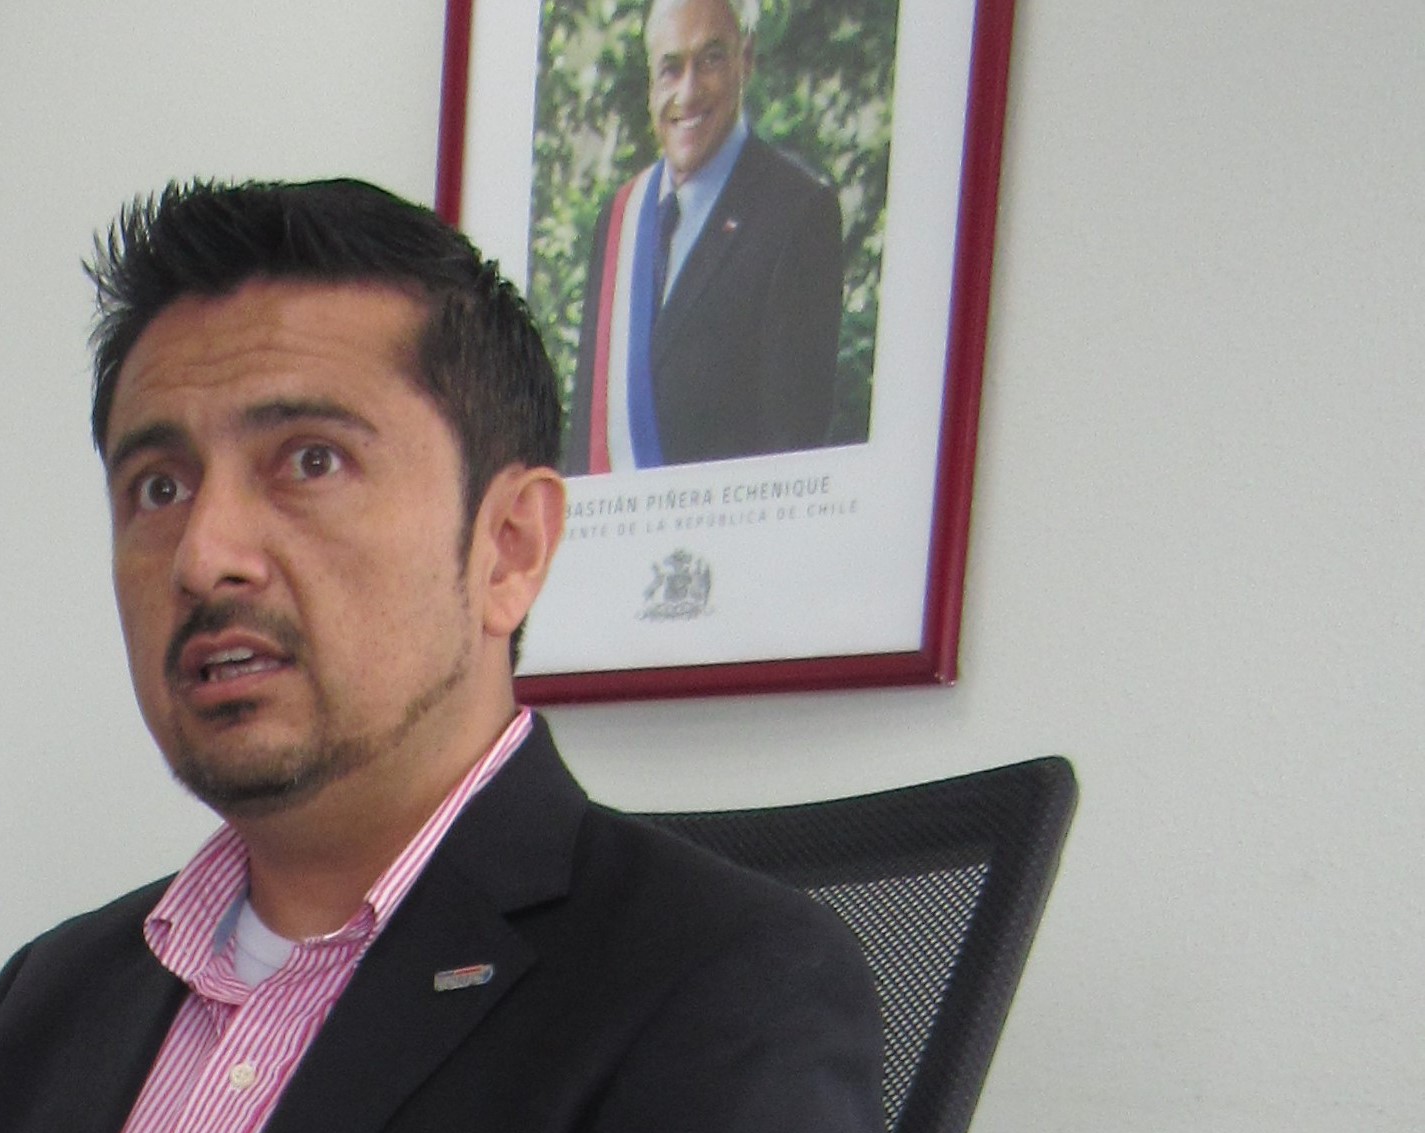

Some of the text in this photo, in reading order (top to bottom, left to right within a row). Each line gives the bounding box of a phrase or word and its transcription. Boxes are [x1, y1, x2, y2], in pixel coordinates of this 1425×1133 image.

[646, 488, 712, 512] PIÑERA
[722, 476, 831, 504] ECHENIQUE
[807, 500, 859, 518] CHILE
